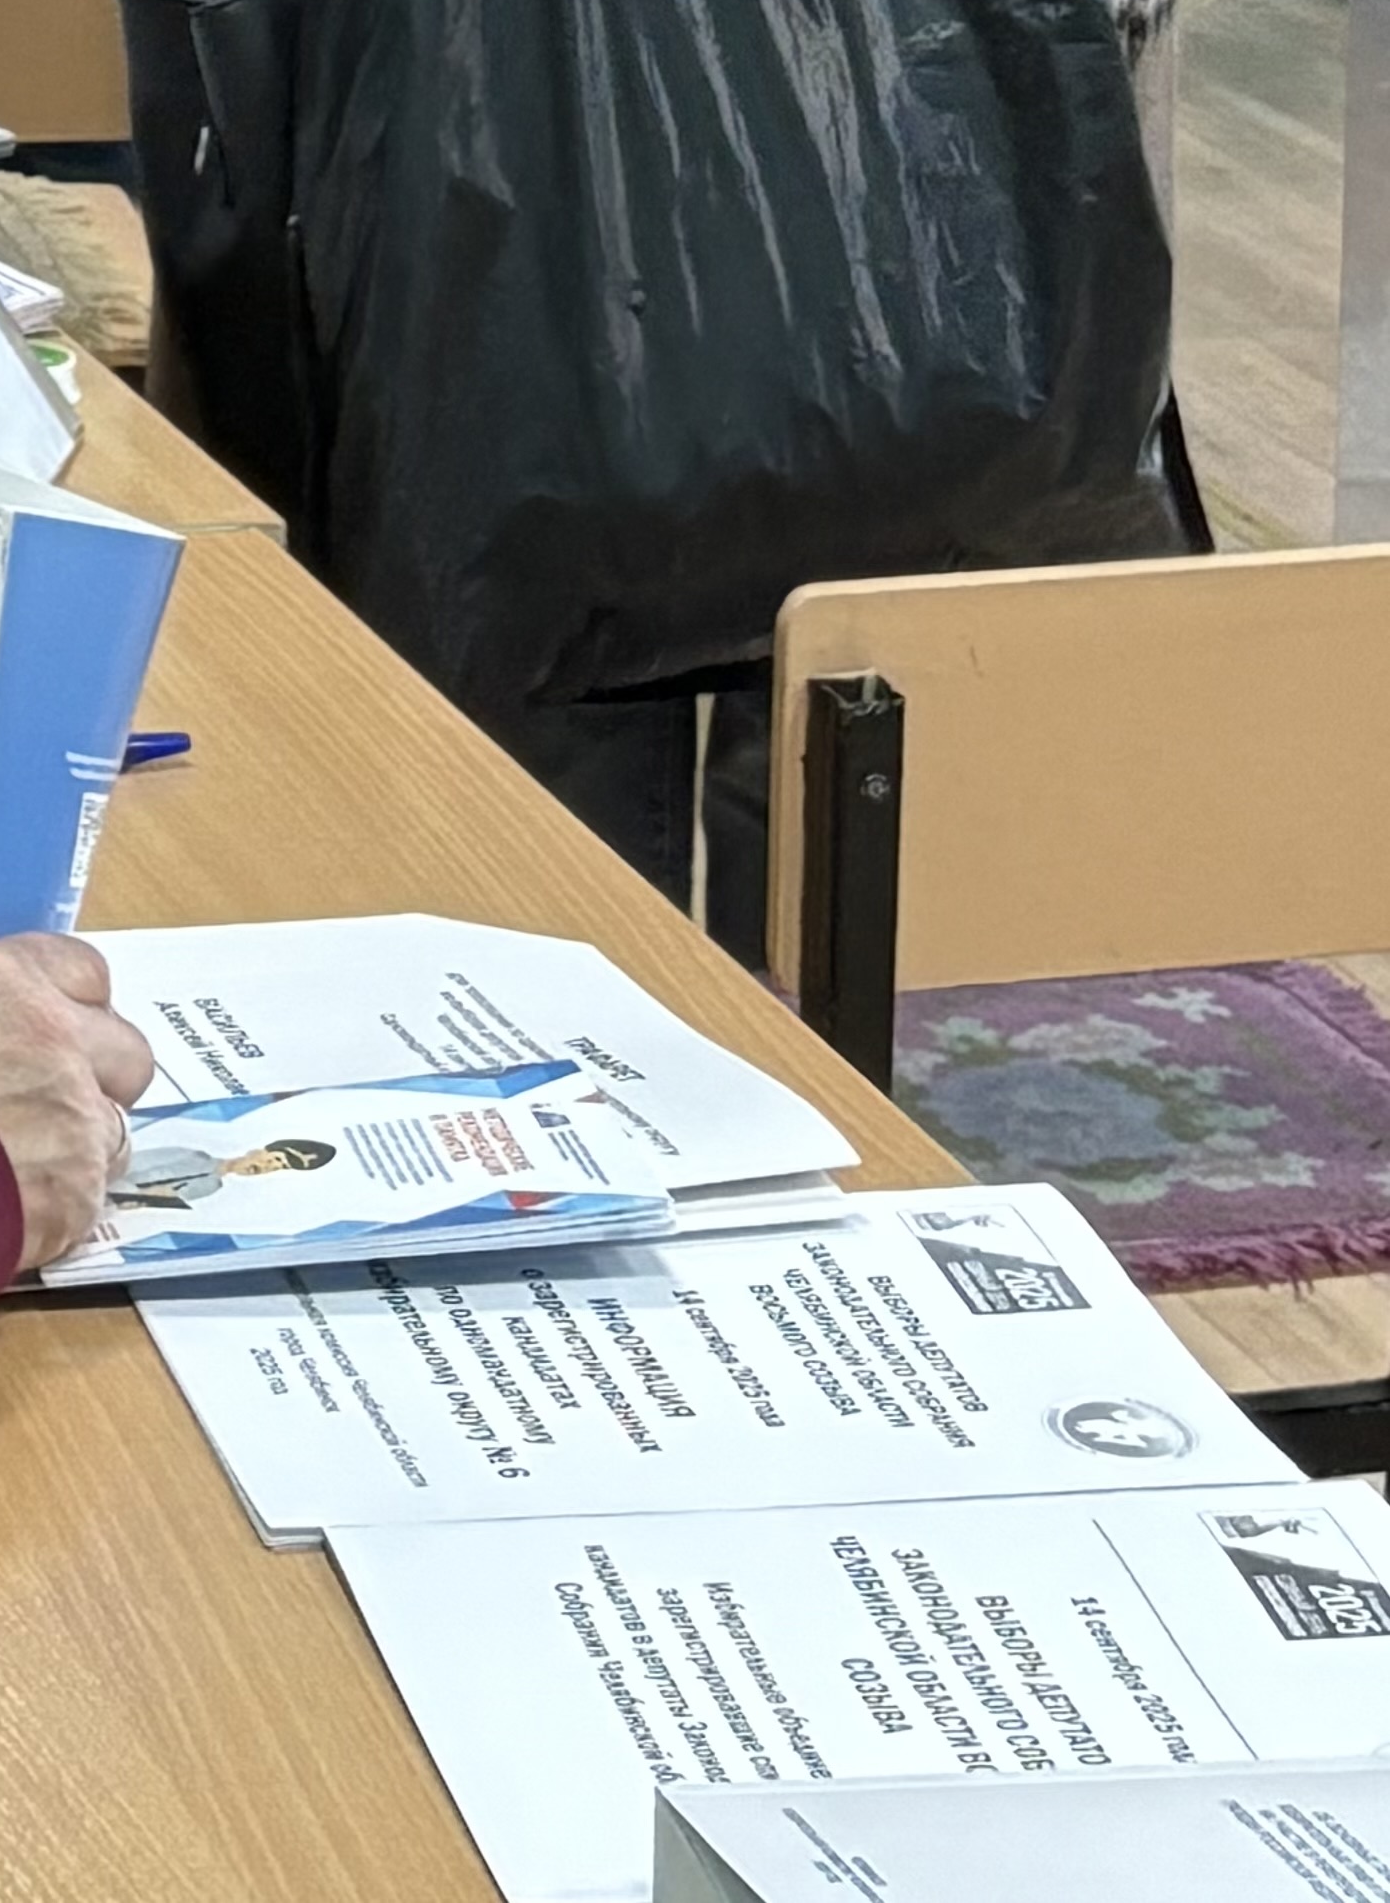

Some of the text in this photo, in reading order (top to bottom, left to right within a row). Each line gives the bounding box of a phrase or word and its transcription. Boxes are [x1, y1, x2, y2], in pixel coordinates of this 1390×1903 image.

[748, 1284, 862, 1416] ВОСЬМОГО СОЗЫВА
[783, 1268, 915, 1427] ЧЕЛЯБИНСКОЙ ОБЛАСТИ
[802, 1242, 976, 1448] ЗАКОНОДАТЕЛЬНОГО СОБРАНИЯ
[867, 1275, 989, 1412] ВЫБОРЫ ДЕПУТАТОВ
[994, 1267, 1060, 1311] 2025
[449, 1308, 555, 1445] одномандатному
[501, 1316, 582, 1409] кандидатах
[527, 1281, 663, 1453] зарегистрированных
[586, 1298, 697, 1417] ИНФОРМАЦИЯ
[726, 1366, 771, 1398] 2025
[447, 1391, 499, 1442] округу
[497, 1467, 530, 1478] 6
[584, 1545, 646, 1631] кандидатов
[632, 1648, 693, 1717] депутаты
[677, 1722, 731, 1783] Законод
[829, 1536, 937, 1666] ЧЕЛЯБИНСКОЙ
[905, 1670, 982, 1748] ОБЛАСТИ
[891, 1548, 1056, 1771] ЗАКОНОДАТЕЛЬНОГО СОБ
[1070, 1597, 1106, 1616] 14
[1085, 1620, 1148, 1691] сентября
[1308, 1583, 1382, 1635] 2025
[702, 1582, 833, 1779] Избирательные объедине
[841, 1658, 913, 1734] СОЗЫВА
[975, 1595, 1112, 1765] ВЫБОРЫ ДЕПУТАТО
[1133, 1694, 1184, 1733] 2025
